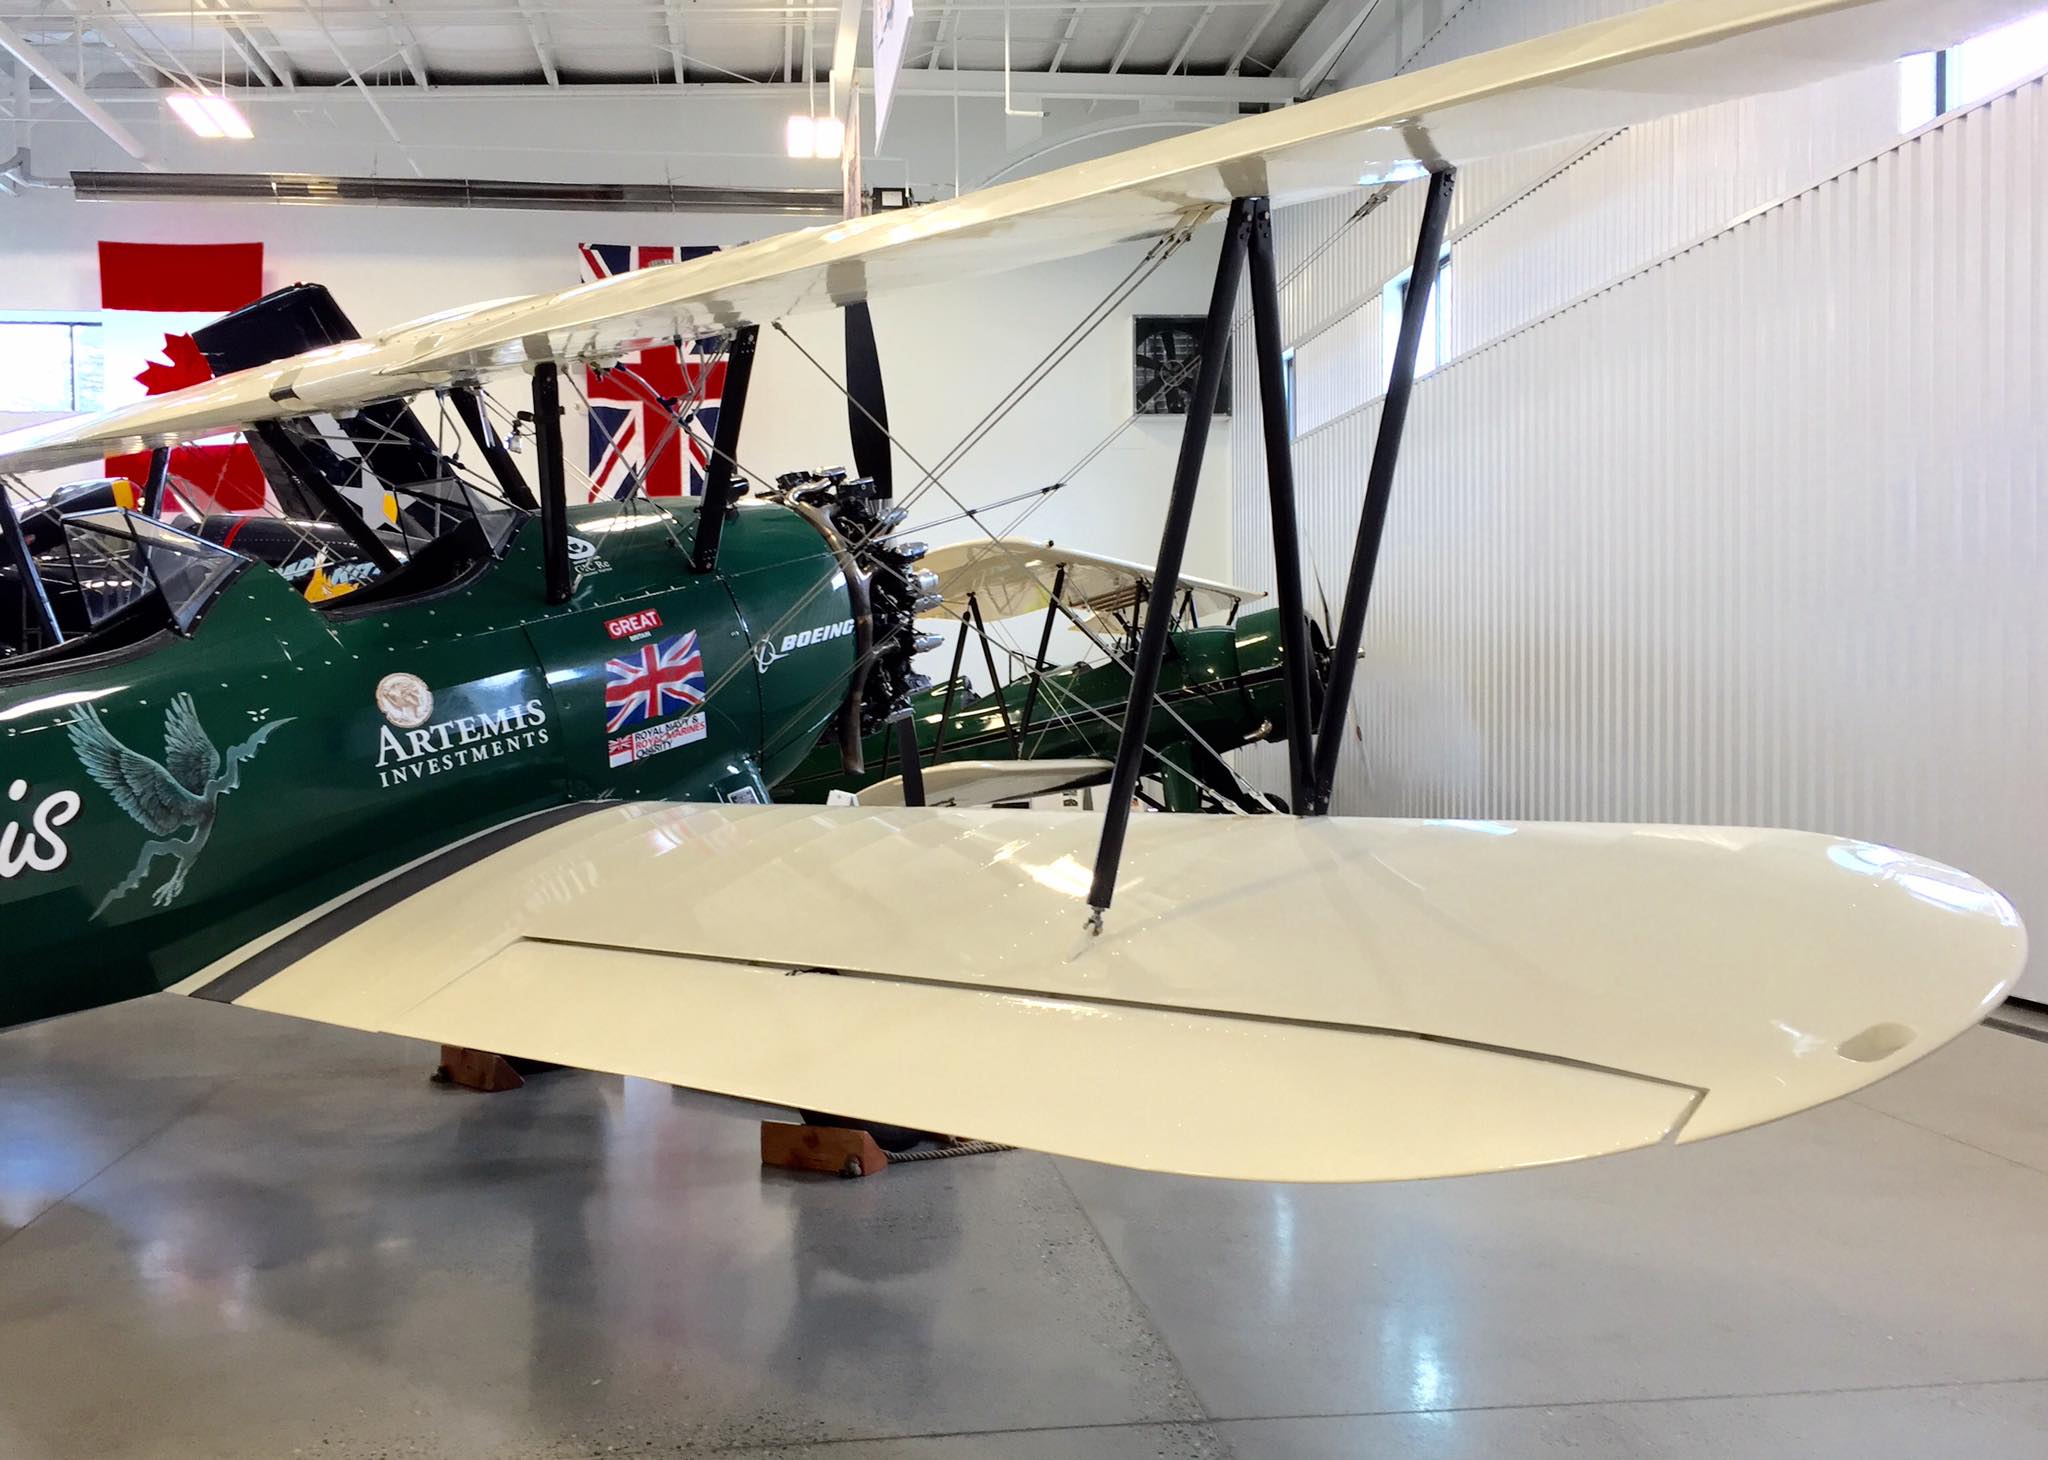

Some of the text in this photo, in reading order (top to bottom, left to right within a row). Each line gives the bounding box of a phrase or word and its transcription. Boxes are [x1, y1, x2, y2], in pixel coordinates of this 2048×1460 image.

[608, 611, 659, 636] GREAT
[780, 618, 856, 652] BOEING
[375, 698, 547, 768] ARTEMIS
[634, 715, 699, 742] ROYAL NAVY &
[635, 722, 705, 750] ROYAL MARINES
[378, 728, 550, 788] INVESTMENTS
